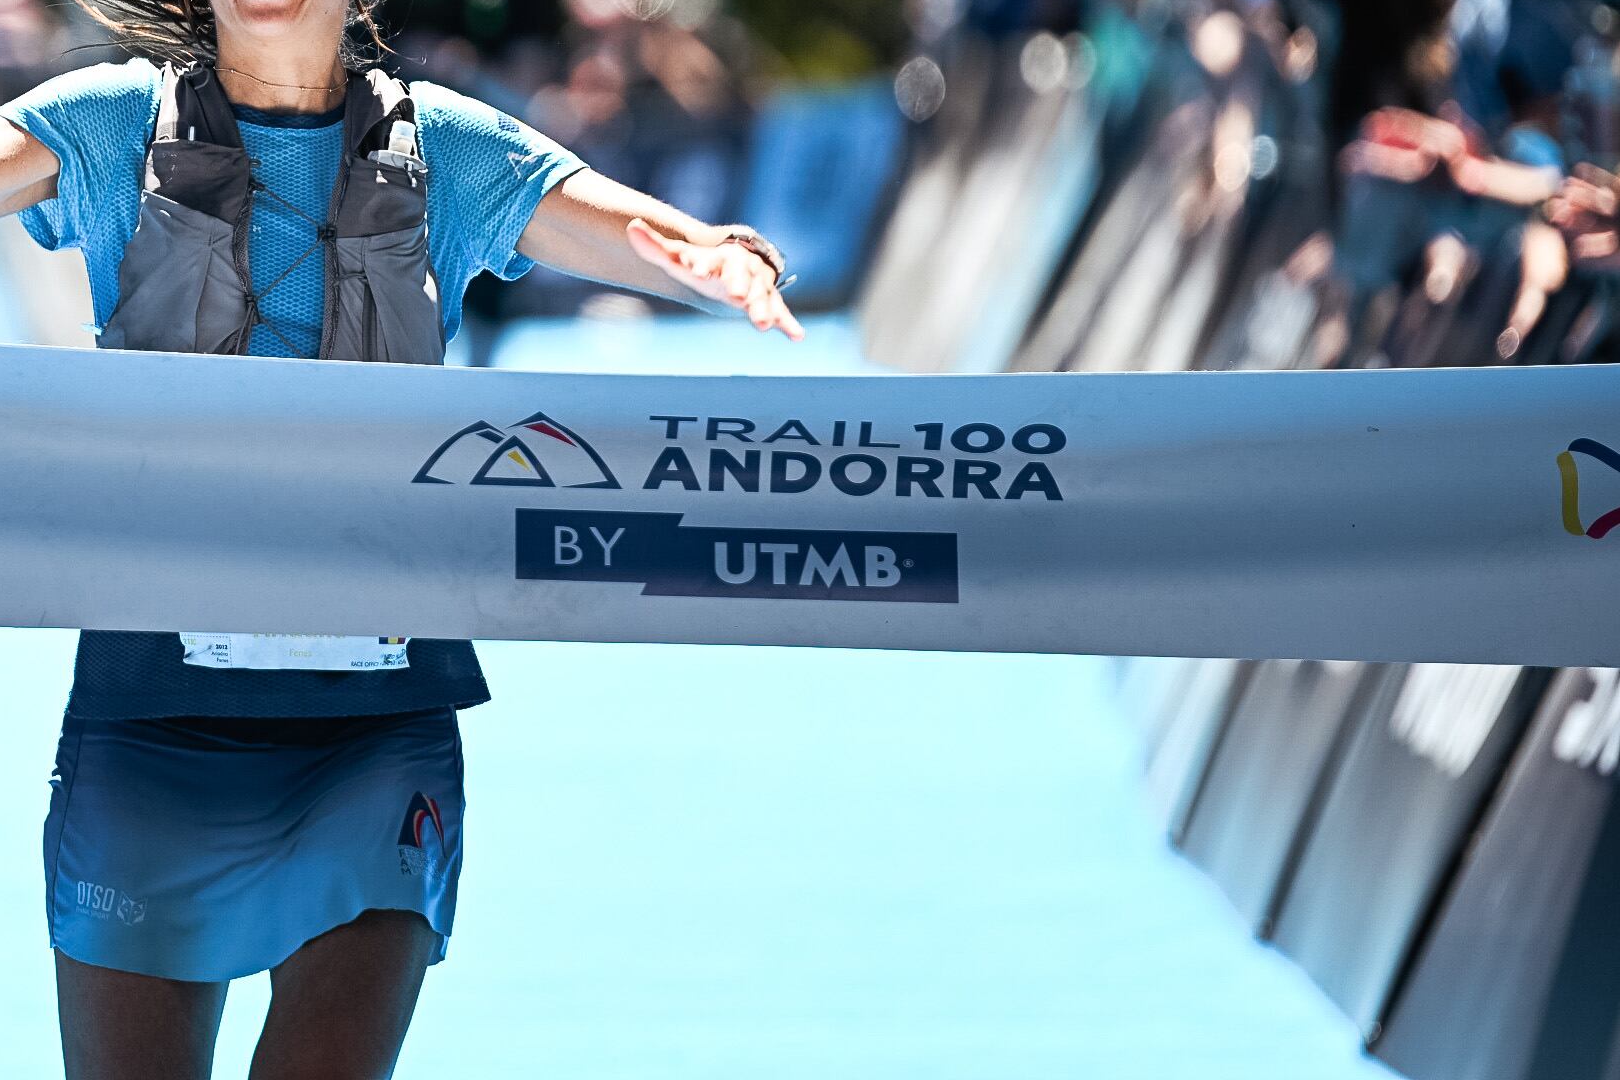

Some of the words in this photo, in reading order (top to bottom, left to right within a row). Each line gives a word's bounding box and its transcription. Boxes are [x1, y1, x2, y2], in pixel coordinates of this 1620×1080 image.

[649, 415, 901, 449] TRAIL
[913, 422, 1067, 455] 100
[642, 446, 1064, 501] ANDORRA
[554, 525, 626, 567] BY
[77, 880, 115, 912] OTSO
